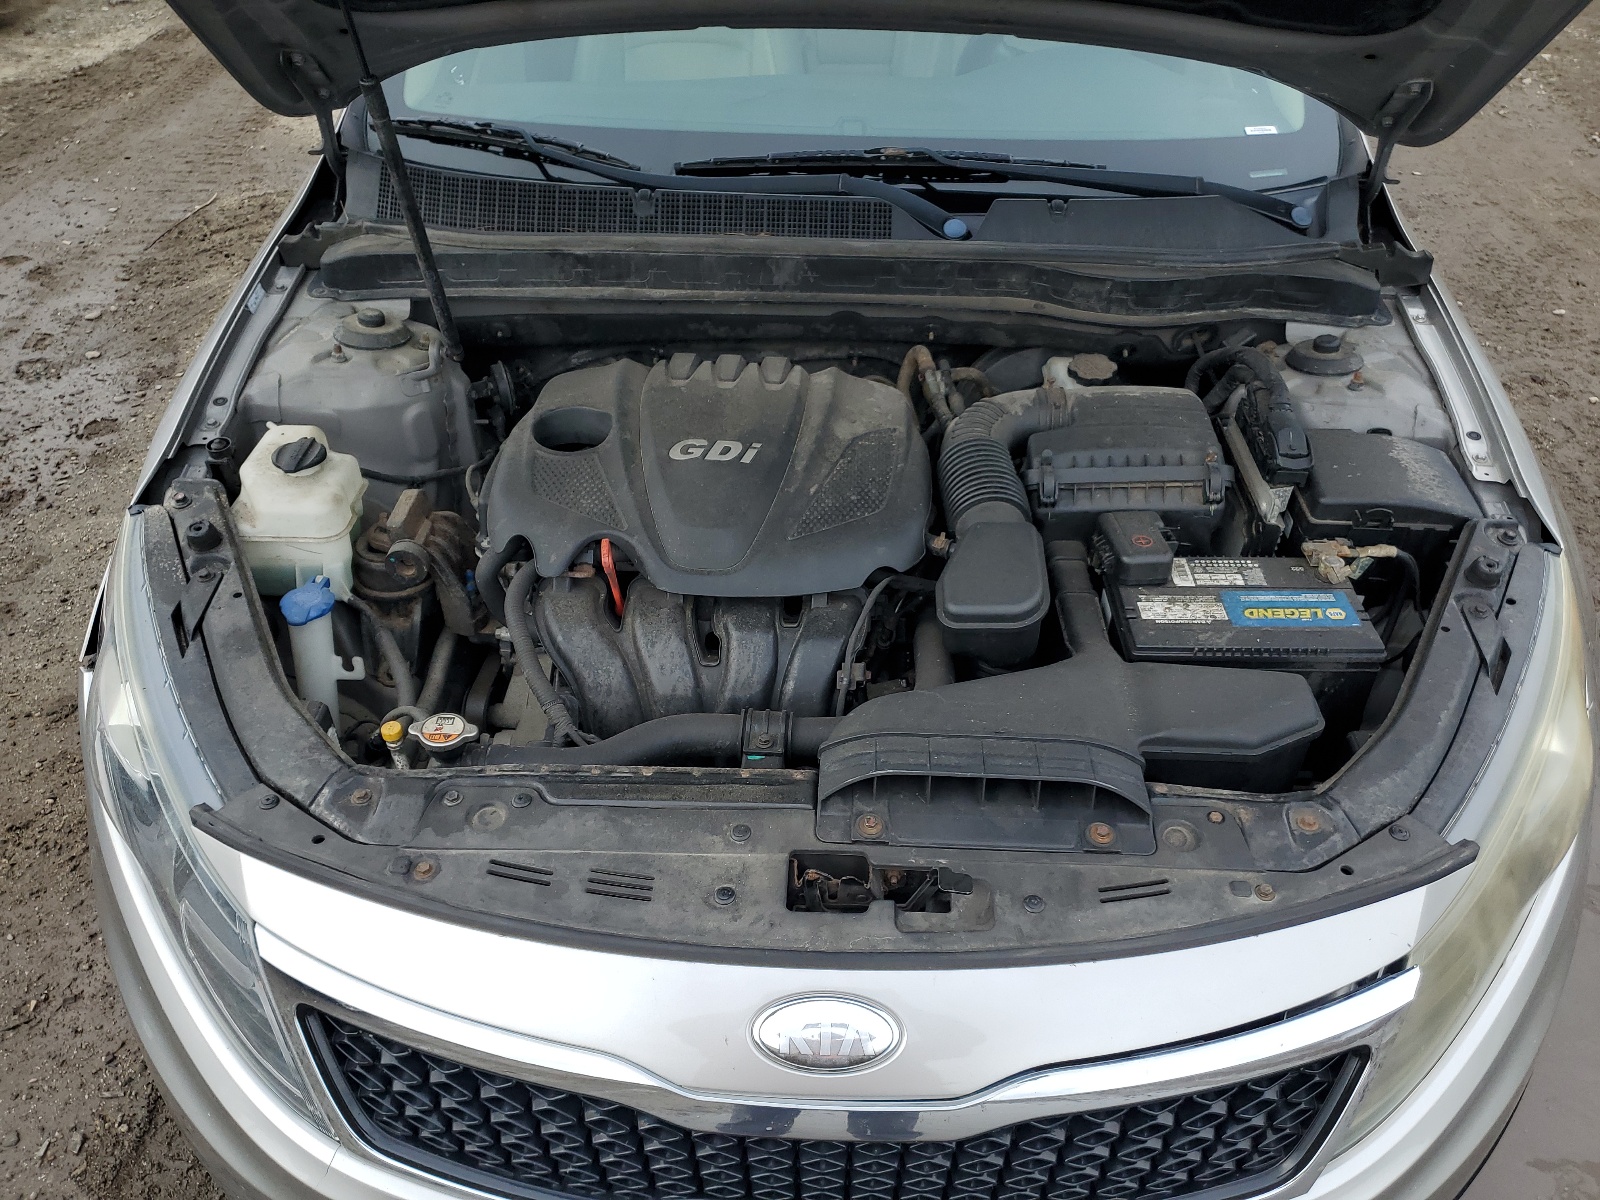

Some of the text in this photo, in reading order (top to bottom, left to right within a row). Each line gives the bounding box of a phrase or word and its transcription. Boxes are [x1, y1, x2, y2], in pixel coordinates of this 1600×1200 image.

[668, 439, 762, 463] GDi
[1244, 608, 1323, 619] LEGEND
[778, 1023, 876, 1056] KIA
